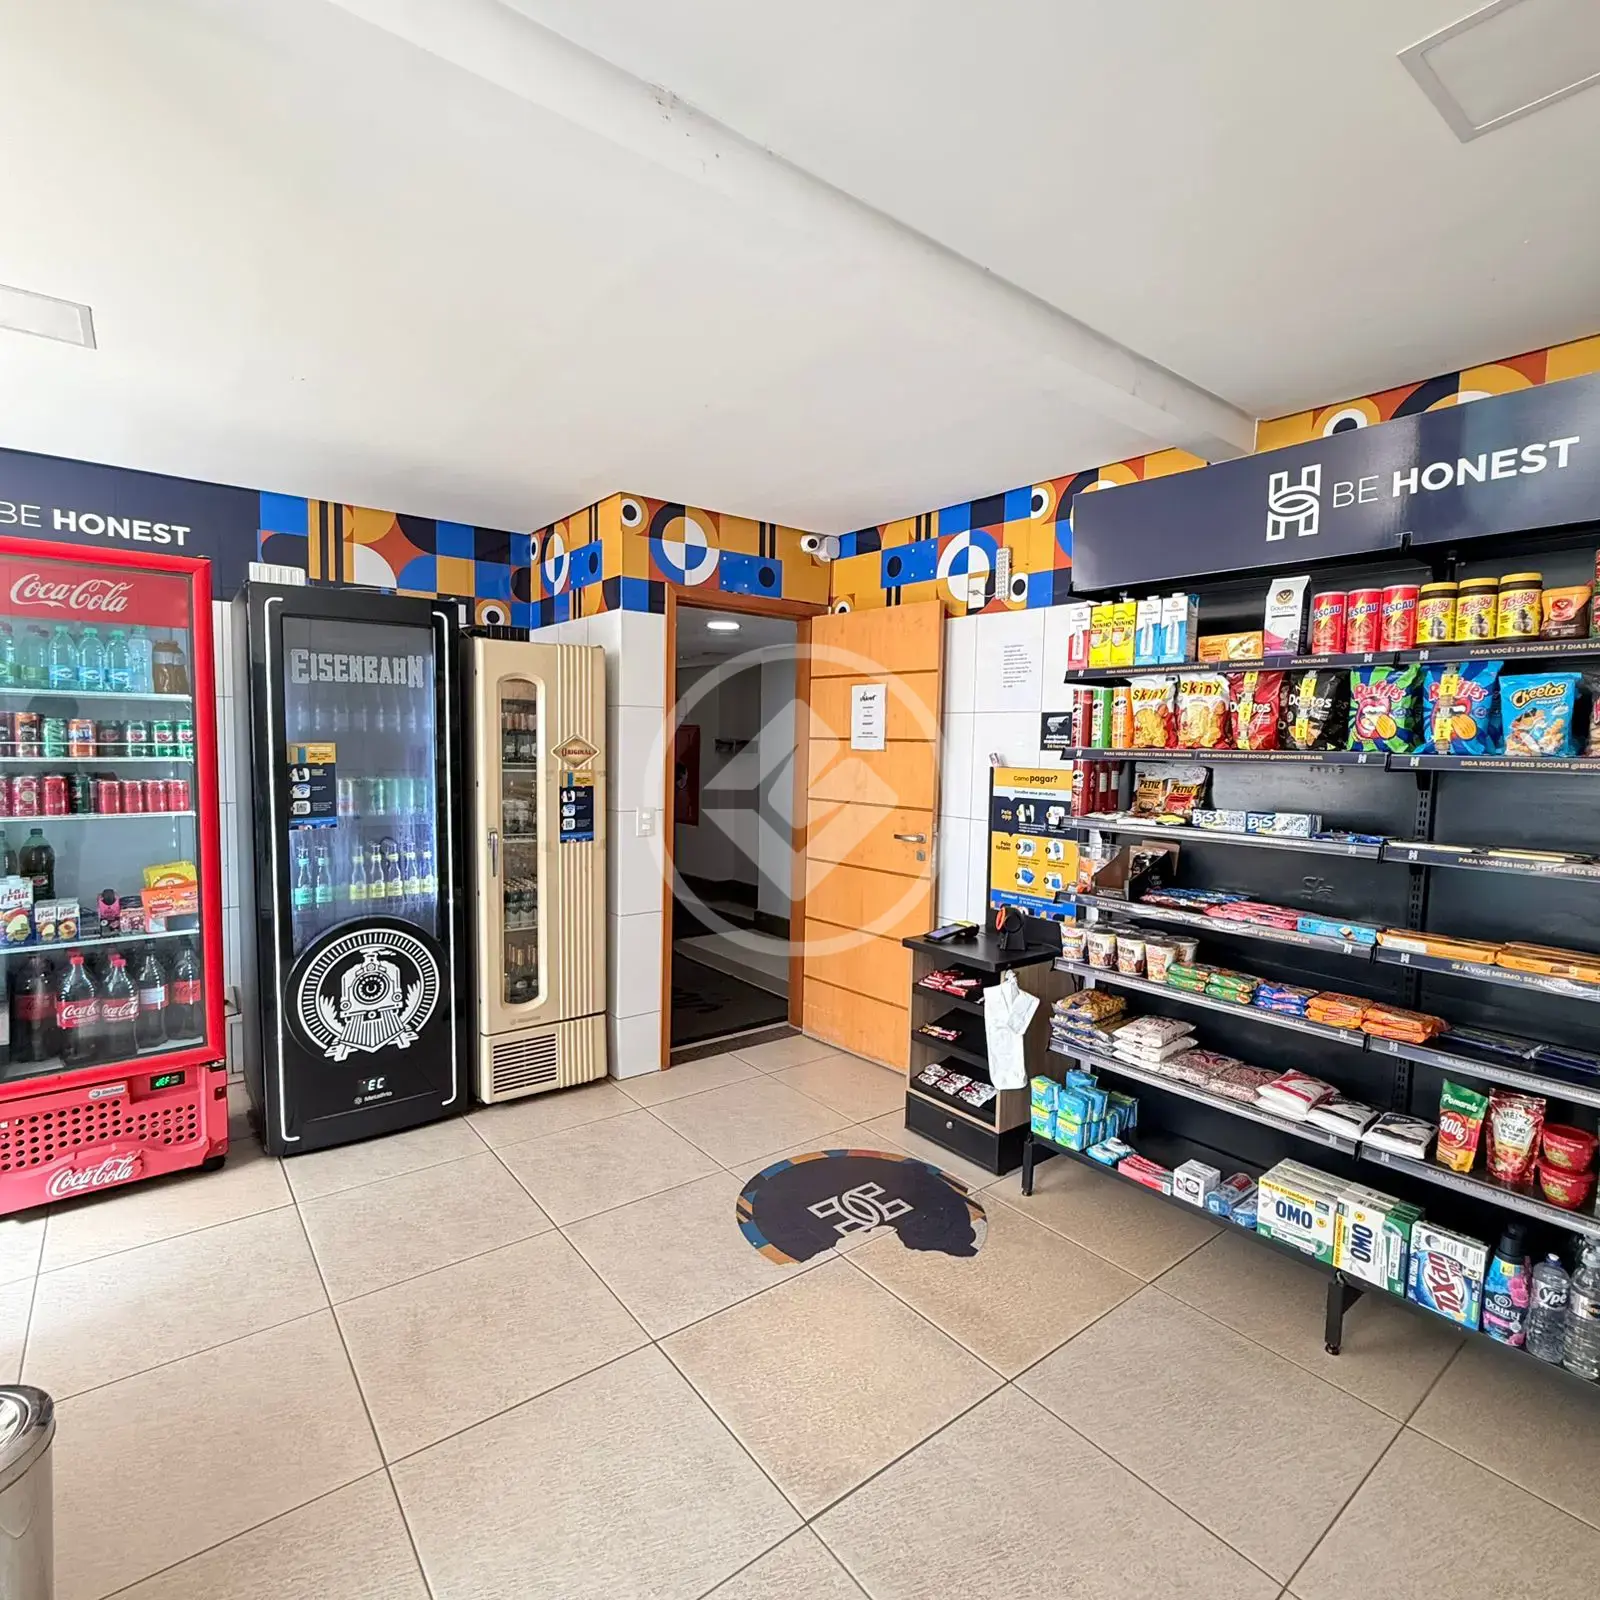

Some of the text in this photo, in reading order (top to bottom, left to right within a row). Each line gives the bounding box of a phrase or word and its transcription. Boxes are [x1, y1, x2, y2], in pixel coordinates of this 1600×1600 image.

[1333, 436, 1580, 508] BE HONEST
[0, 501, 191, 546] BE HONEST
[10, 573, 134, 613] Coca-Cola
[1502, 591, 1537, 613] Toddy
[1314, 605, 1342, 621] ESCAU
[1348, 603, 1379, 620] ESCAU
[1420, 601, 1451, 619] Toddy
[1459, 595, 1493, 615] Toddy
[291, 648, 424, 688] EISENBAHN
[1288, 693, 1332, 709] Dotos
[1354, 679, 1406, 702] Ruffles
[1428, 678, 1489, 702] Rfles
[1510, 681, 1568, 709] Cheetos
[1229, 701, 1271, 713] Dtos
[561, 748, 593, 757] ORIGINAL
[1029, 775, 1058, 784] pagar?
[1458, 857, 1478, 865] PARA
[368, 1077, 385, 1091] EC
[1442, 1093, 1478, 1112] Pomarola
[1440, 1116, 1465, 1141] 300g
[49, 1149, 143, 1197] Coca-Cola
[1275, 1199, 1313, 1230] OMO
[1350, 1222, 1373, 1264] OMO
[1485, 1298, 1522, 1321] Downy
